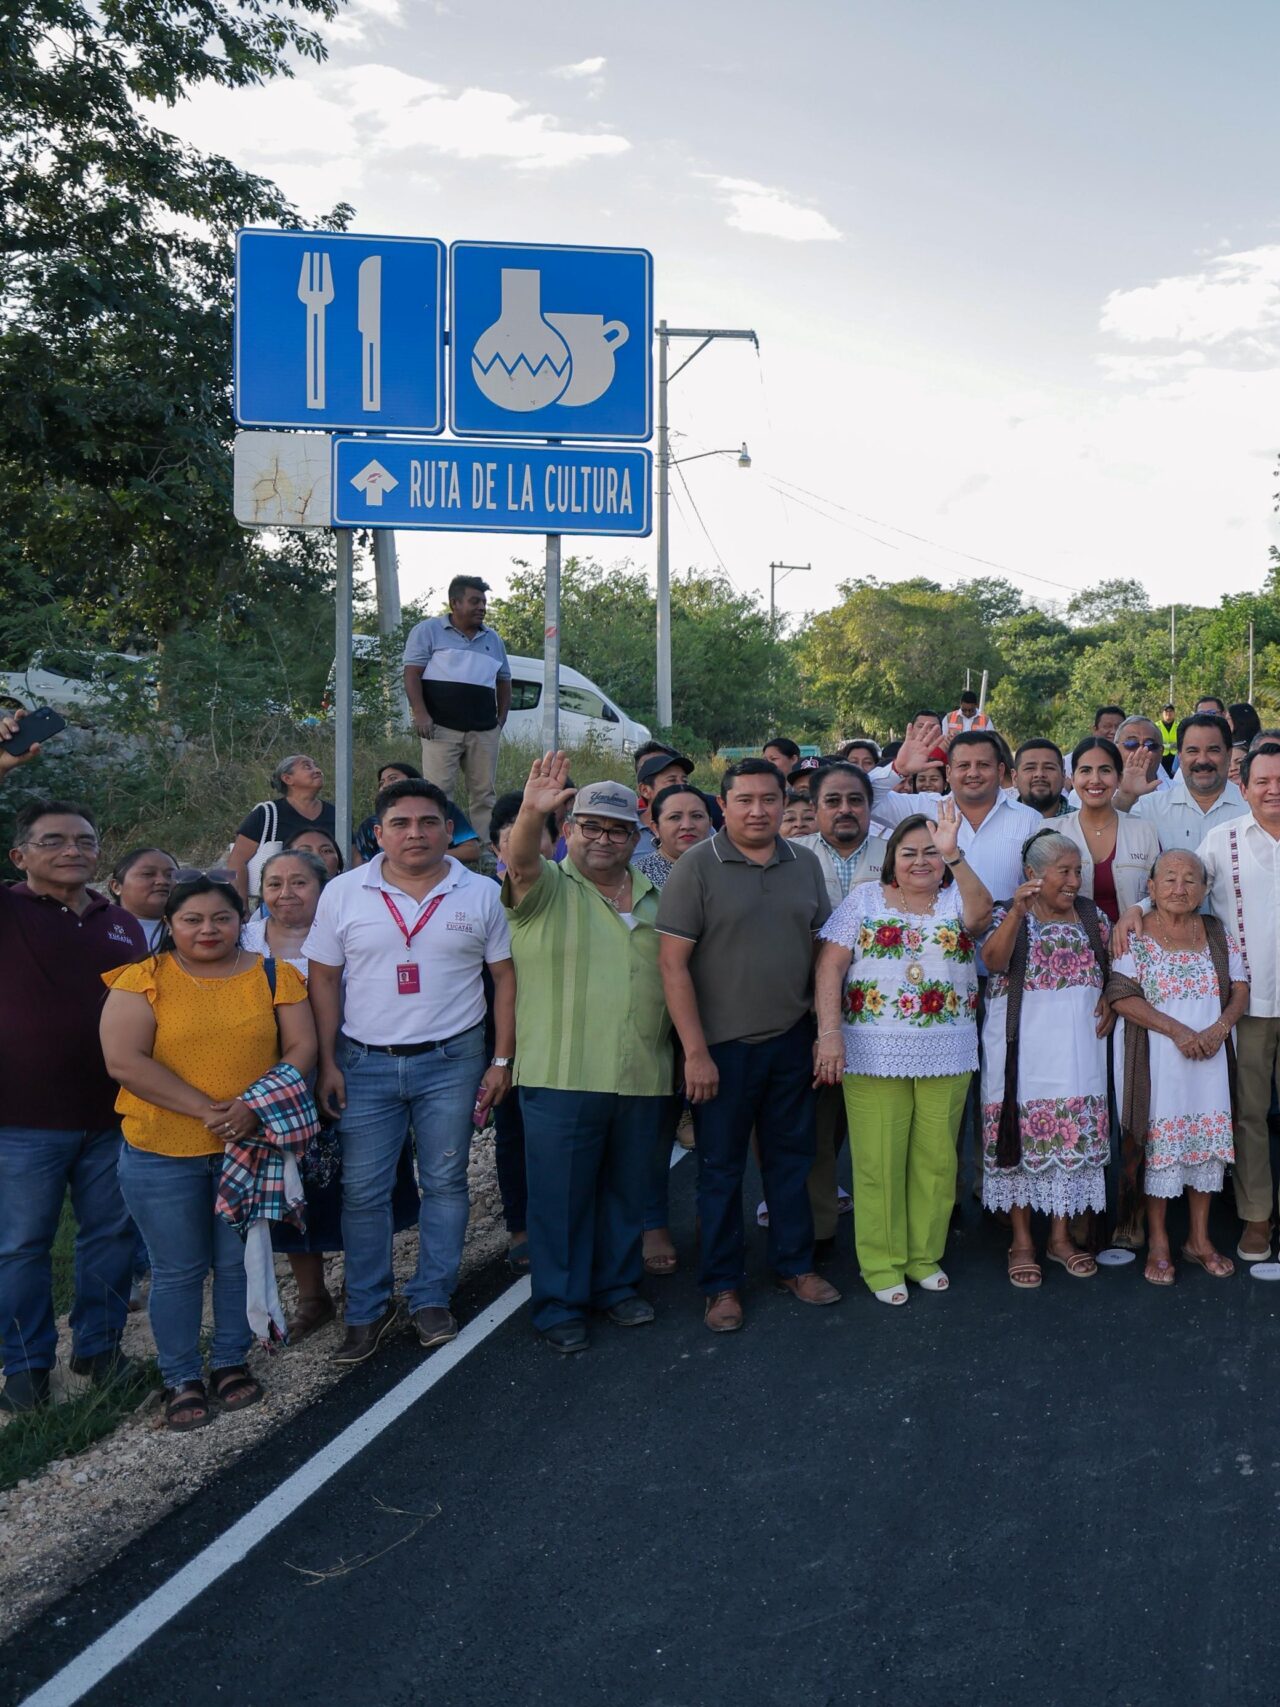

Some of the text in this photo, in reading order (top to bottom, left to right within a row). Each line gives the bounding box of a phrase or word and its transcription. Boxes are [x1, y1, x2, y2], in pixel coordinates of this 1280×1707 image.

[409, 459, 633, 515] RUTA DE LA CULTURA
